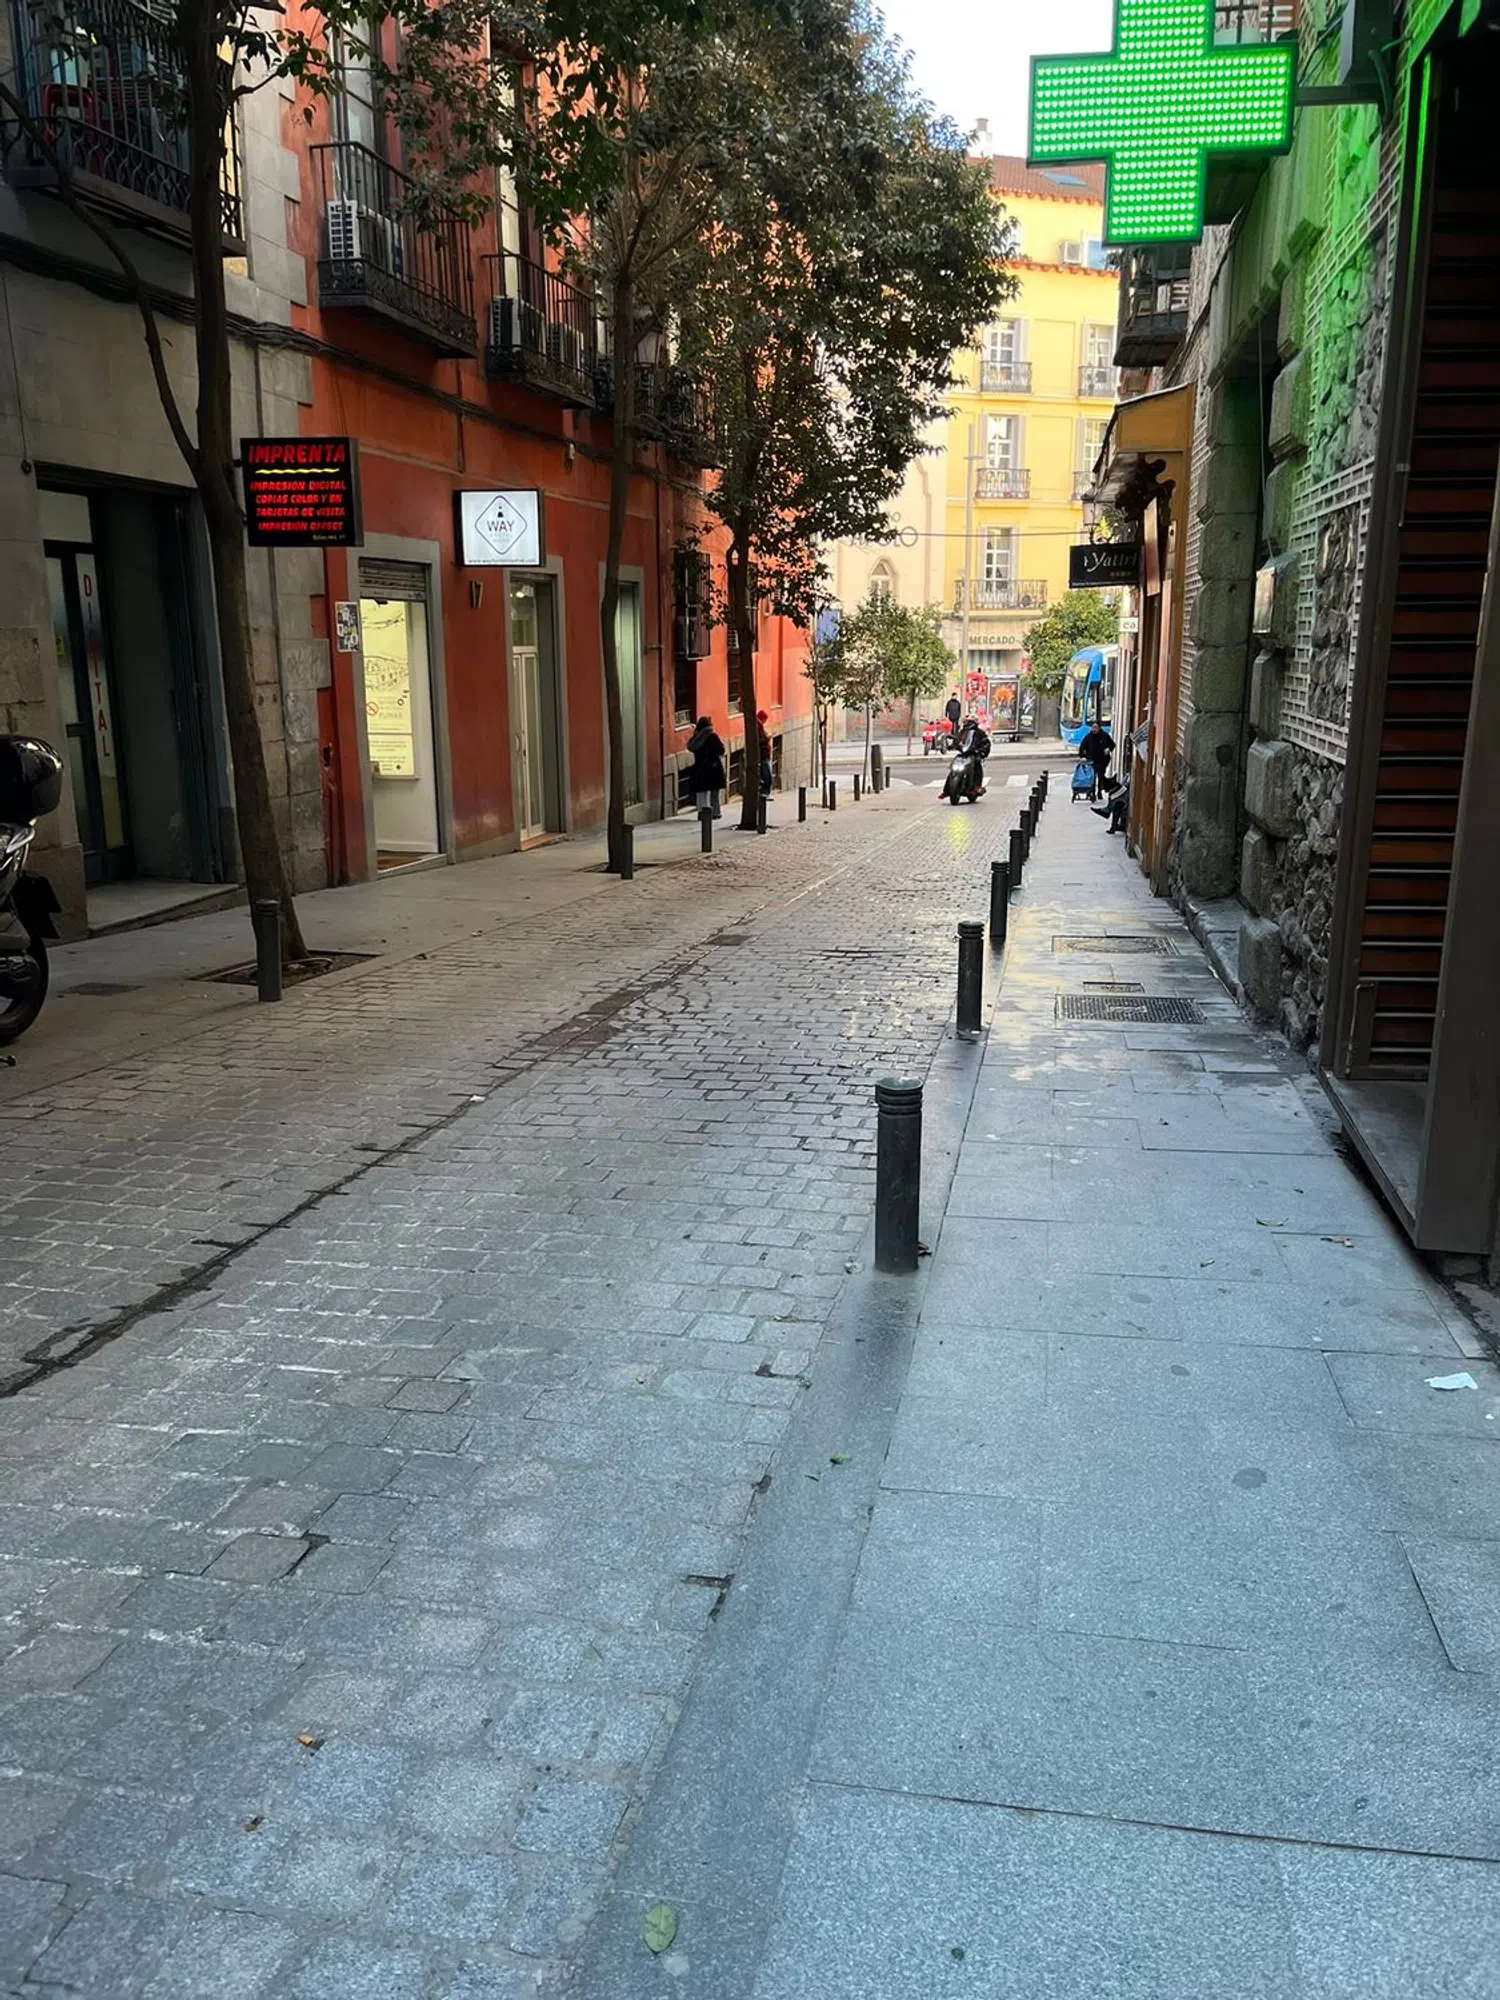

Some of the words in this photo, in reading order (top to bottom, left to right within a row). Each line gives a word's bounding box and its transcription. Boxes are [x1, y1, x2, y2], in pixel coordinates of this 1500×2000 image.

[248, 444, 345, 463] IMPRENTA
[308, 479, 347, 490] DIGITAL
[255, 494, 288, 504] COPIAS
[290, 494, 319, 504] COLOR
[321, 493, 328, 503] Y
[255, 507, 299, 517] TARJETAS
[301, 507, 314, 516] DE
[316, 507, 345, 517] VISITA
[487, 520, 515, 532] WAY
[969, 635, 1016, 645] MERCADO
